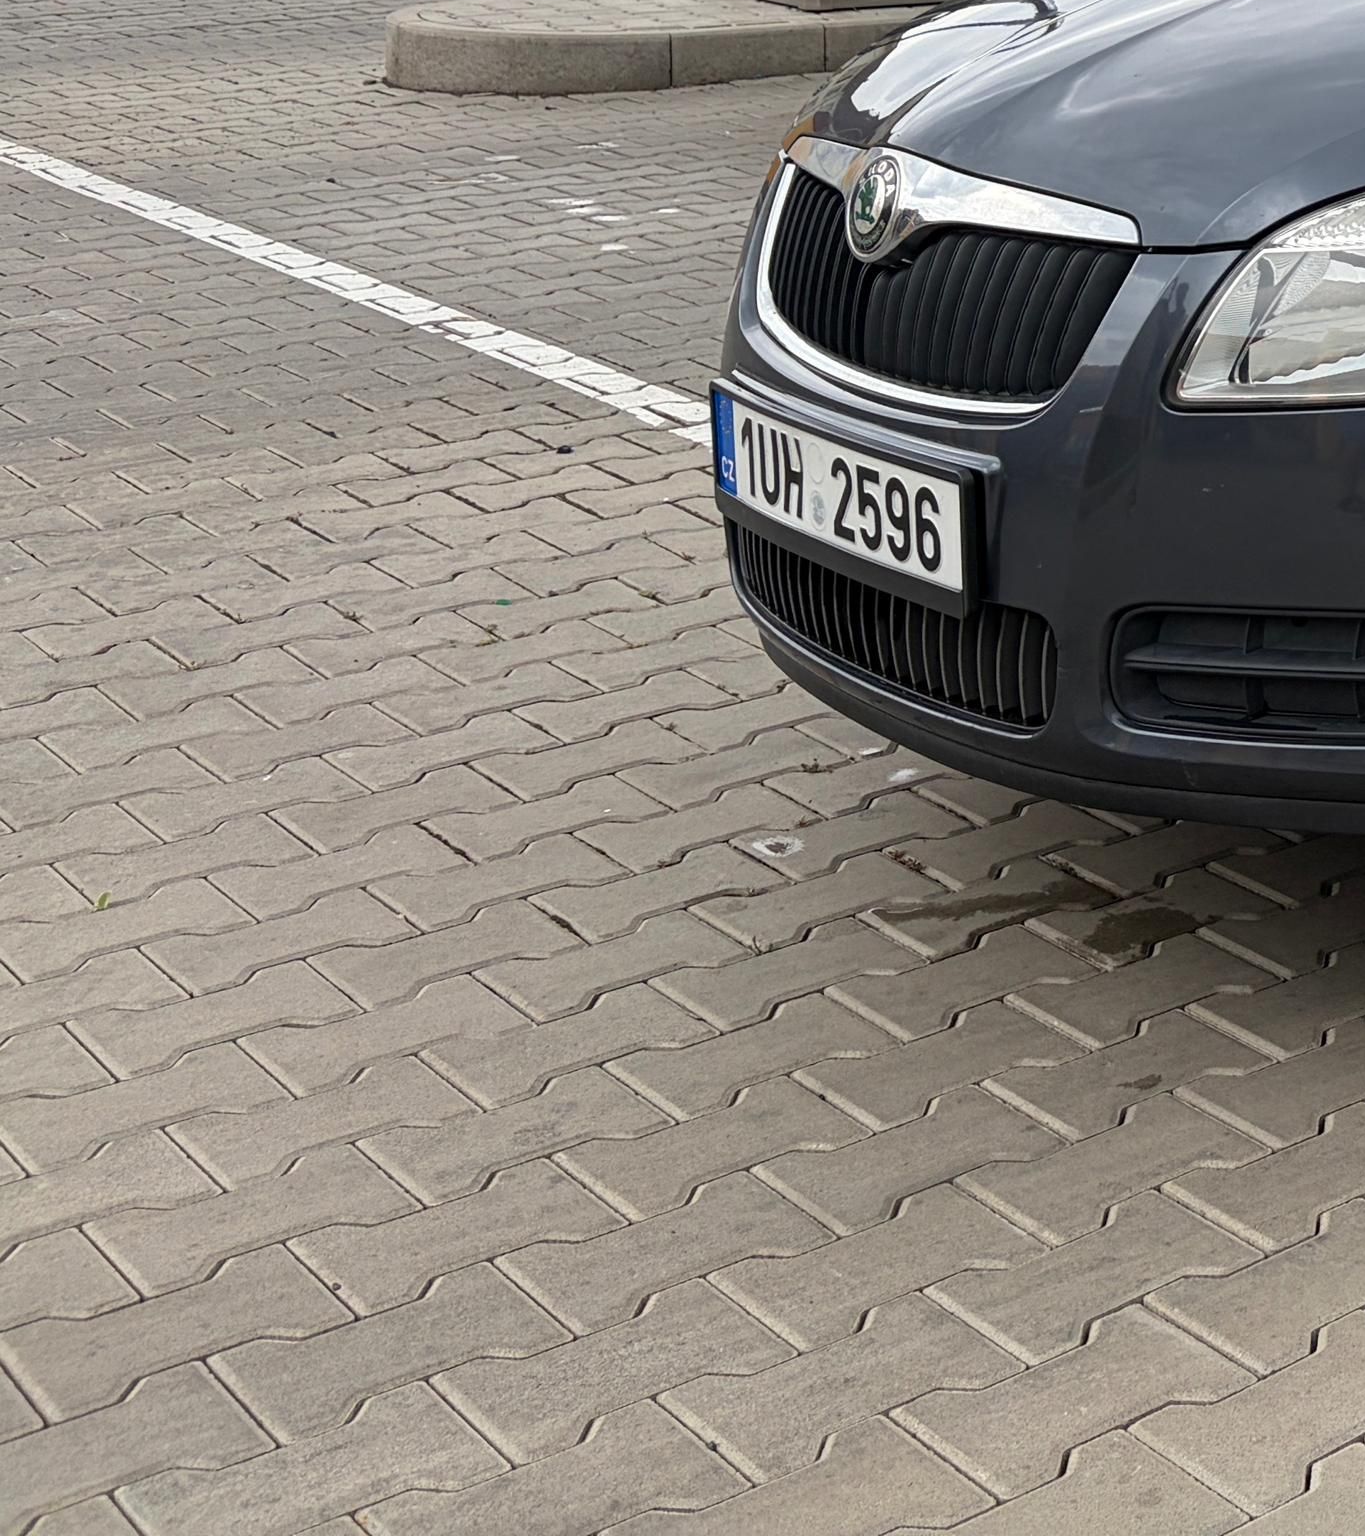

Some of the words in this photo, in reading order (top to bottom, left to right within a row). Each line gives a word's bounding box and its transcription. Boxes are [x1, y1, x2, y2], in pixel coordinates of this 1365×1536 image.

[721, 455, 736, 483] CZ
[741, 417, 804, 520] 1UH
[830, 457, 942, 573] 2596
